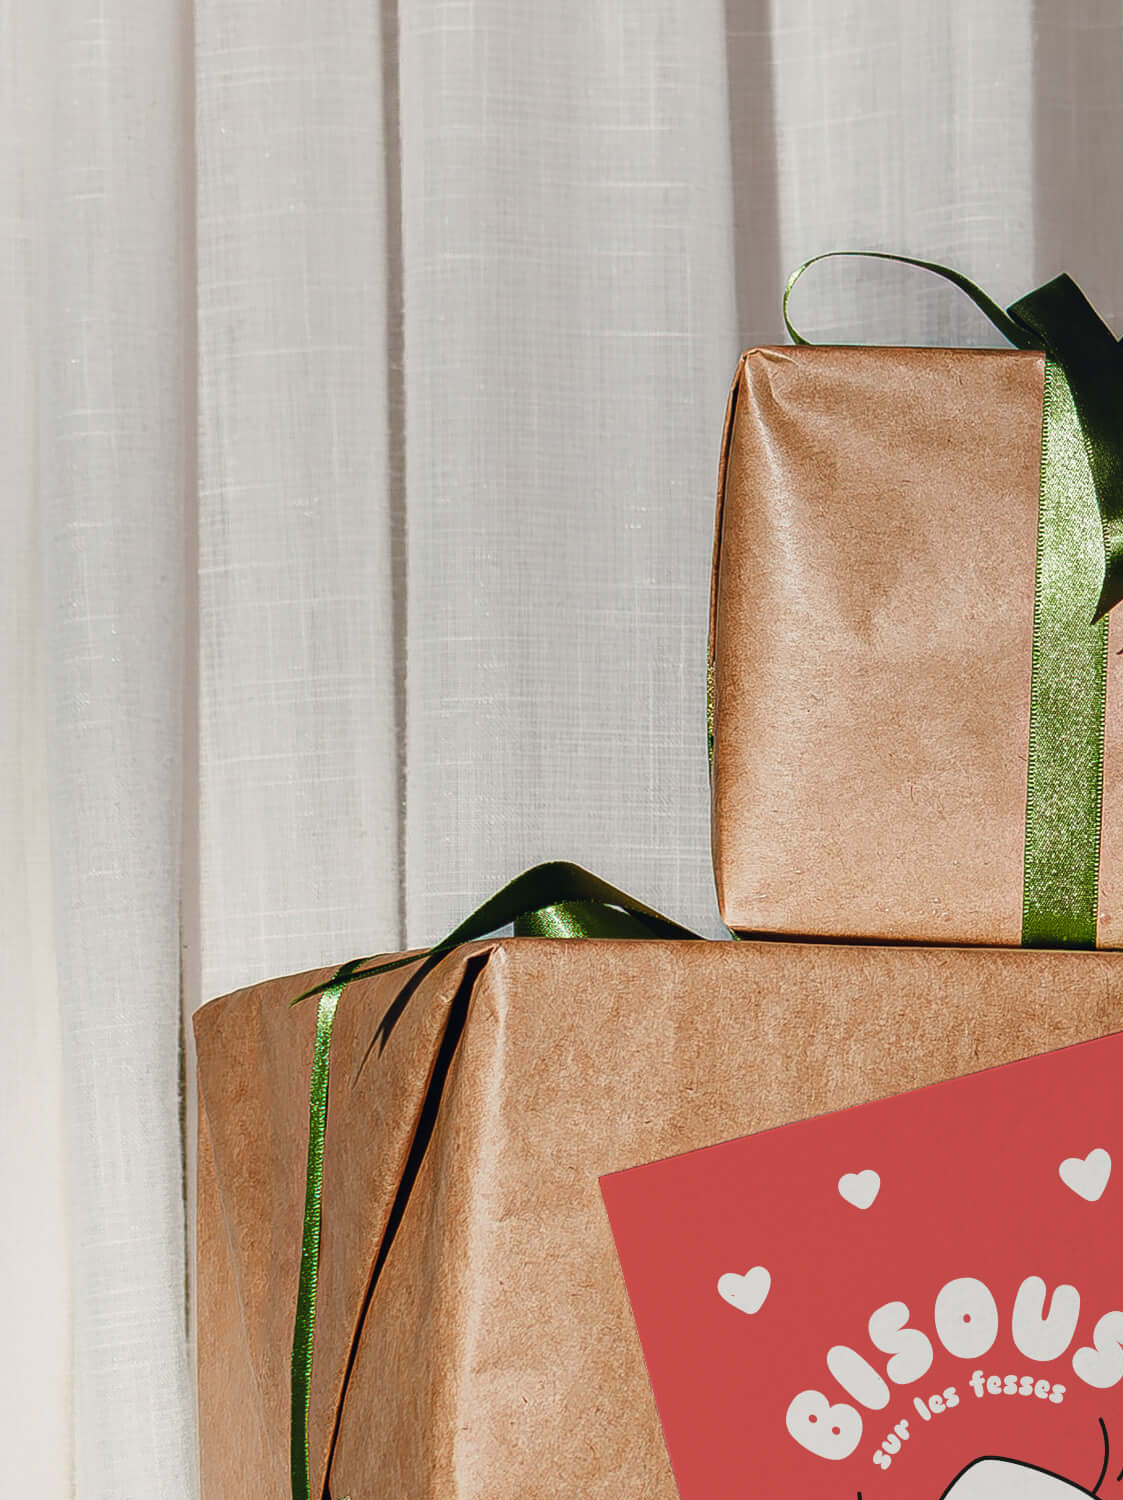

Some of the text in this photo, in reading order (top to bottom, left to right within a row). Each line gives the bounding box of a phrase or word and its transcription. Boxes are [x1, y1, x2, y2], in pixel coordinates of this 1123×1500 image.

[872, 1370, 1067, 1470] sur les fesses
